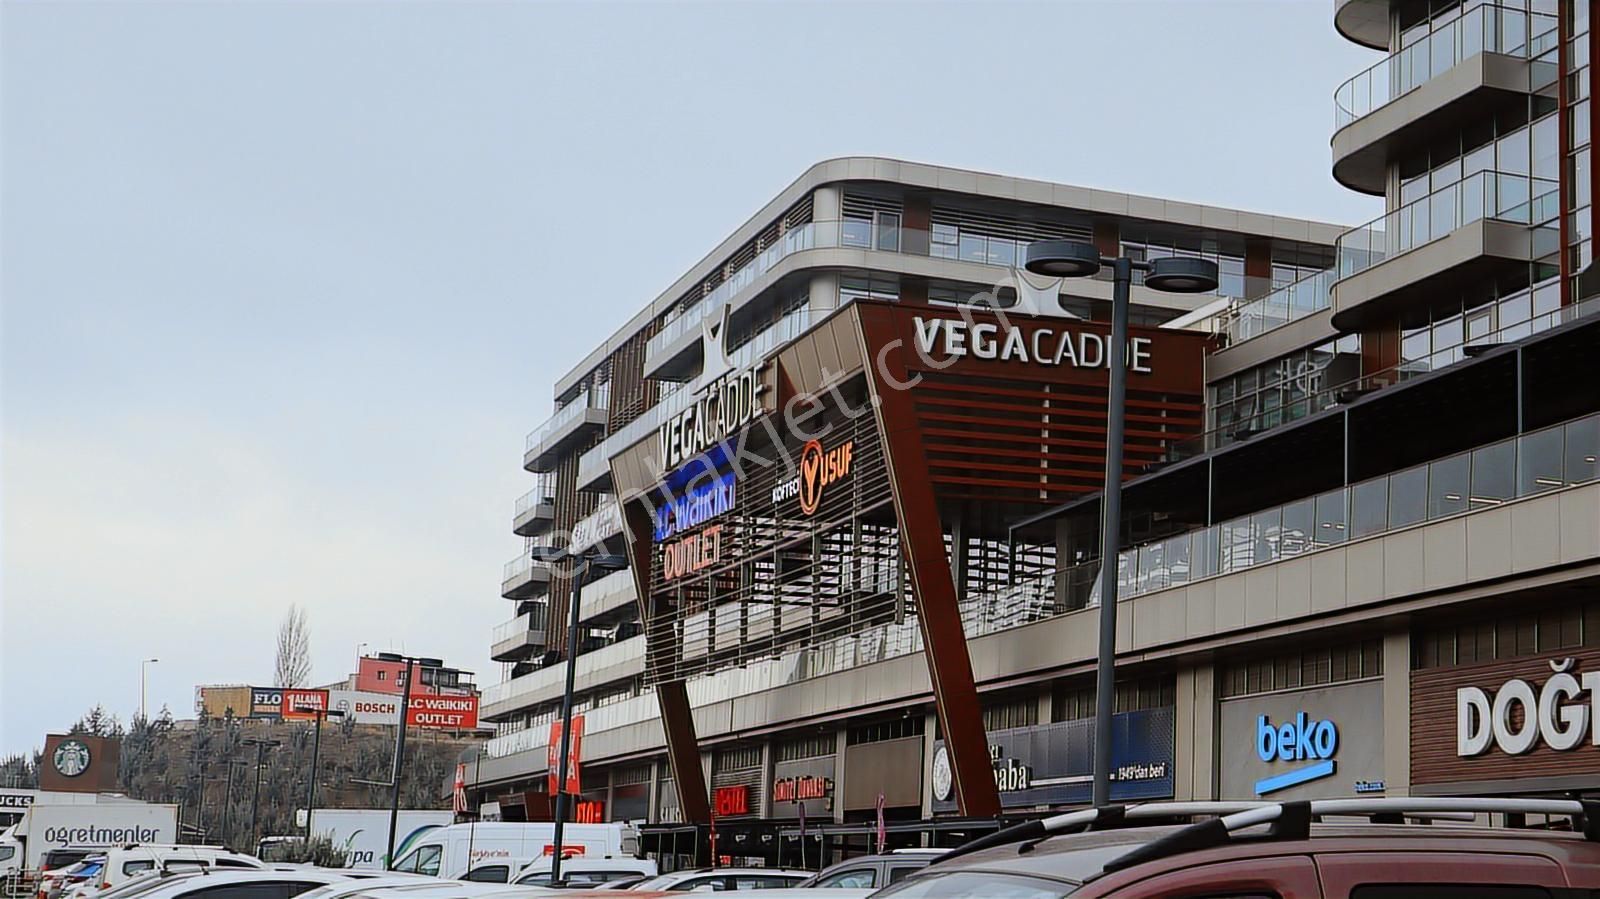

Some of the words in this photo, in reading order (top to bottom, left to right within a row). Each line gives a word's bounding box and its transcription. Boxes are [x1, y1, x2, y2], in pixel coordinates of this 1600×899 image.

[659, 362, 765, 471] VEGACADDE
[664, 524, 723, 580] OUTLET
[253, 693, 282, 705] FLO
[355, 702, 396, 714] BOSCH
[408, 698, 424, 709] LC
[415, 713, 464, 725] OUTLET
[1256, 712, 1338, 762] beko
[992, 758, 1027, 791] aba
